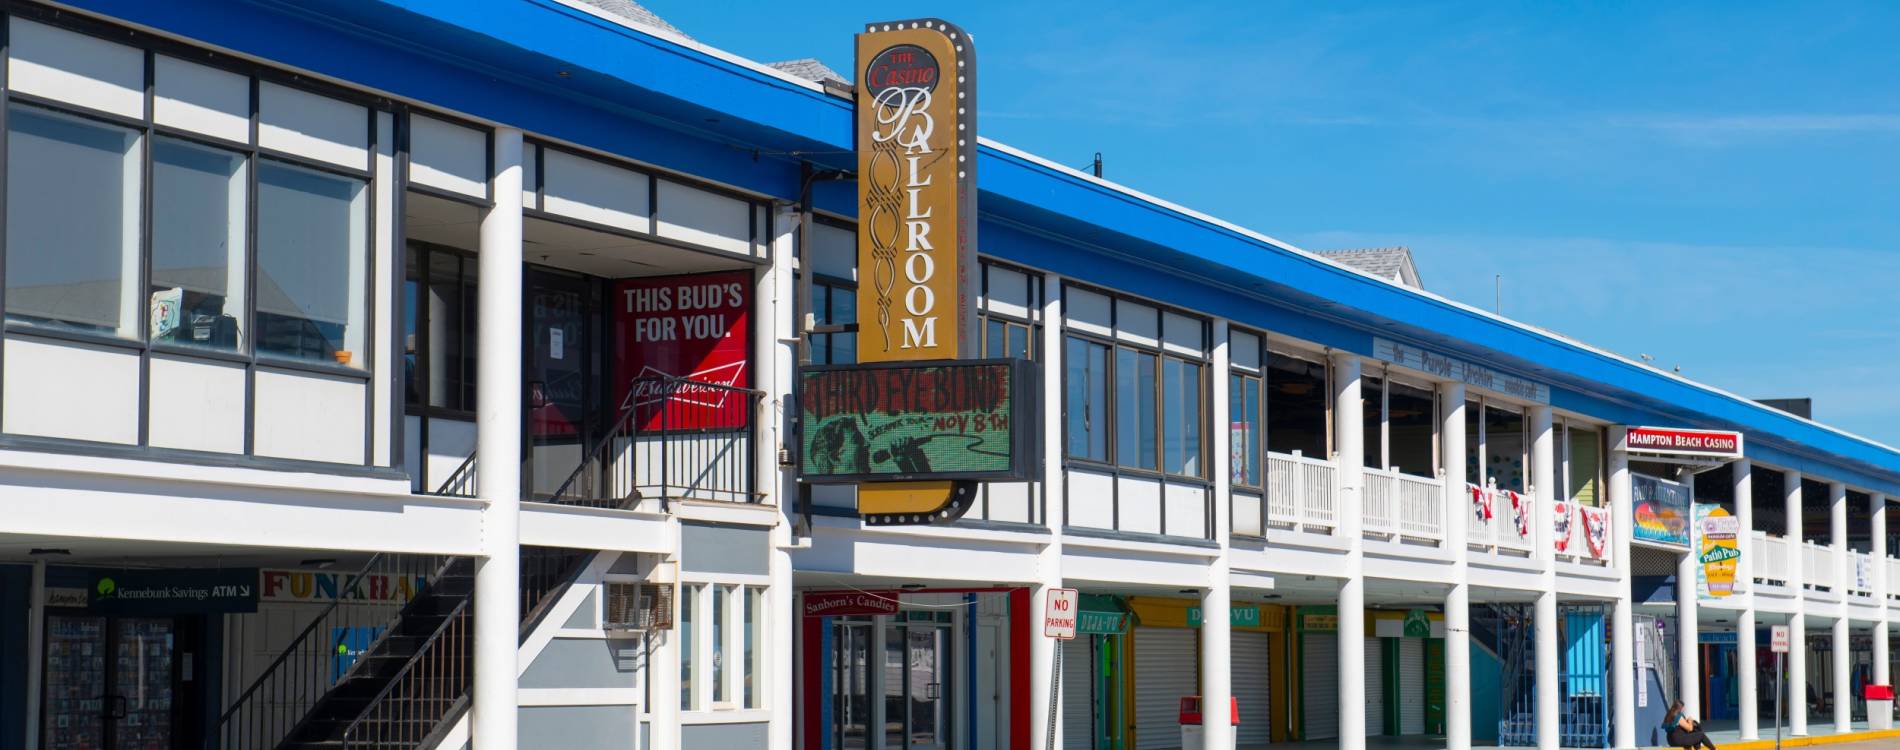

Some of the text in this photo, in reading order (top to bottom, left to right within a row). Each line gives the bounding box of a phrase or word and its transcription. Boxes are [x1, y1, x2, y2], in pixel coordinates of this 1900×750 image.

[870, 64, 935, 88] Casino
[872, 86, 938, 349] BALLROOM
[623, 282, 743, 313] THIS BUD'S
[635, 313, 731, 343] FOR YOU.
[933, 415, 969, 434] NOV
[973, 414, 986, 433] 8
[1629, 432, 1734, 449] HAMPTON BEACH CASINO
[1703, 547, 1739, 562] Patio Pub
[117, 585, 237, 601] Kennebunk Savings ATM
[806, 595, 895, 614] Sanborn's Candies
[1054, 599, 1069, 611] NO
[1046, 617, 1074, 629] PARKING
